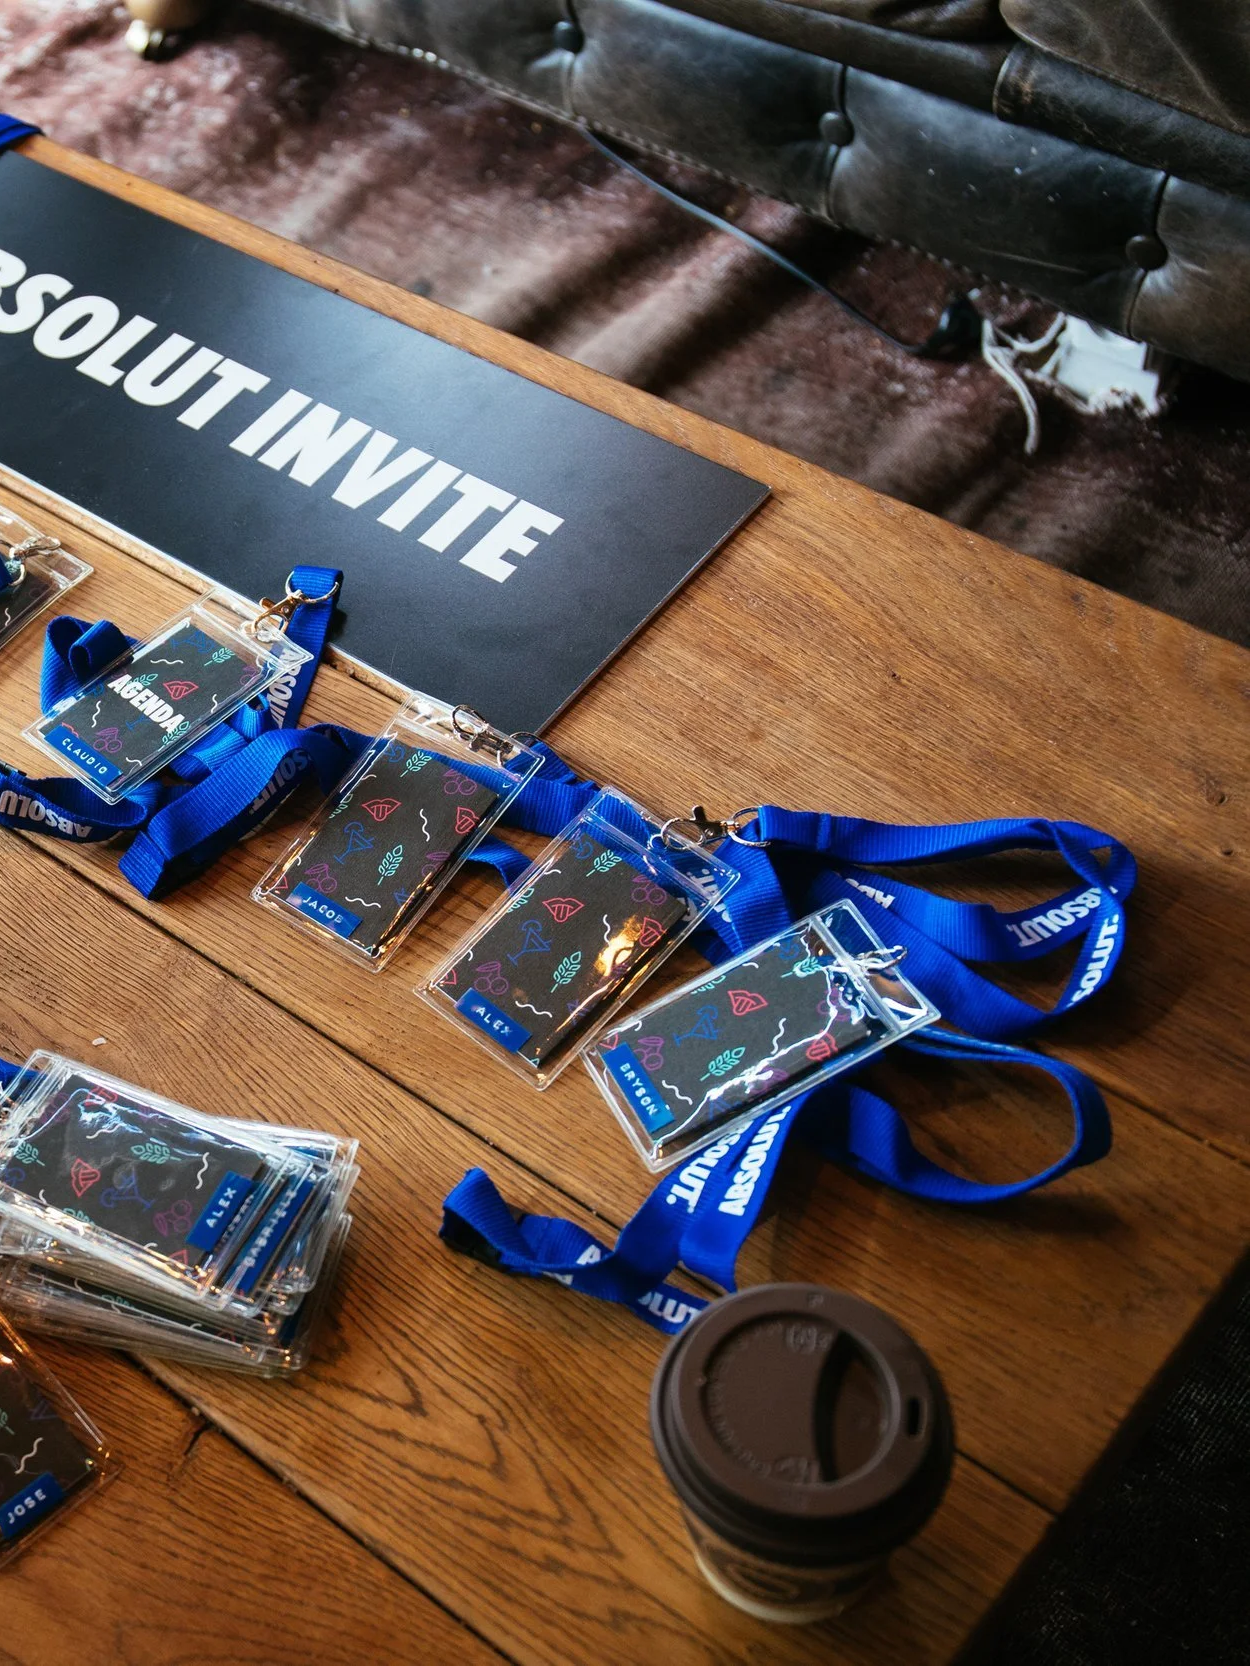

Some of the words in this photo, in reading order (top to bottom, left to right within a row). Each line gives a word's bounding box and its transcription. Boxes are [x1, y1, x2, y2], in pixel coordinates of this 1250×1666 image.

[231, 389, 565, 583] INVITE
[107, 673, 186, 734] AGENDA
[62, 737, 108, 775] CLAUDIO
[475, 1006, 513, 1037] ALEX
[619, 1062, 660, 1116] BRYSON
[718, 1105, 792, 1217] ABSOLUT.
[206, 1187, 237, 1228] ALEX
[7, 1488, 47, 1525] JOSE
